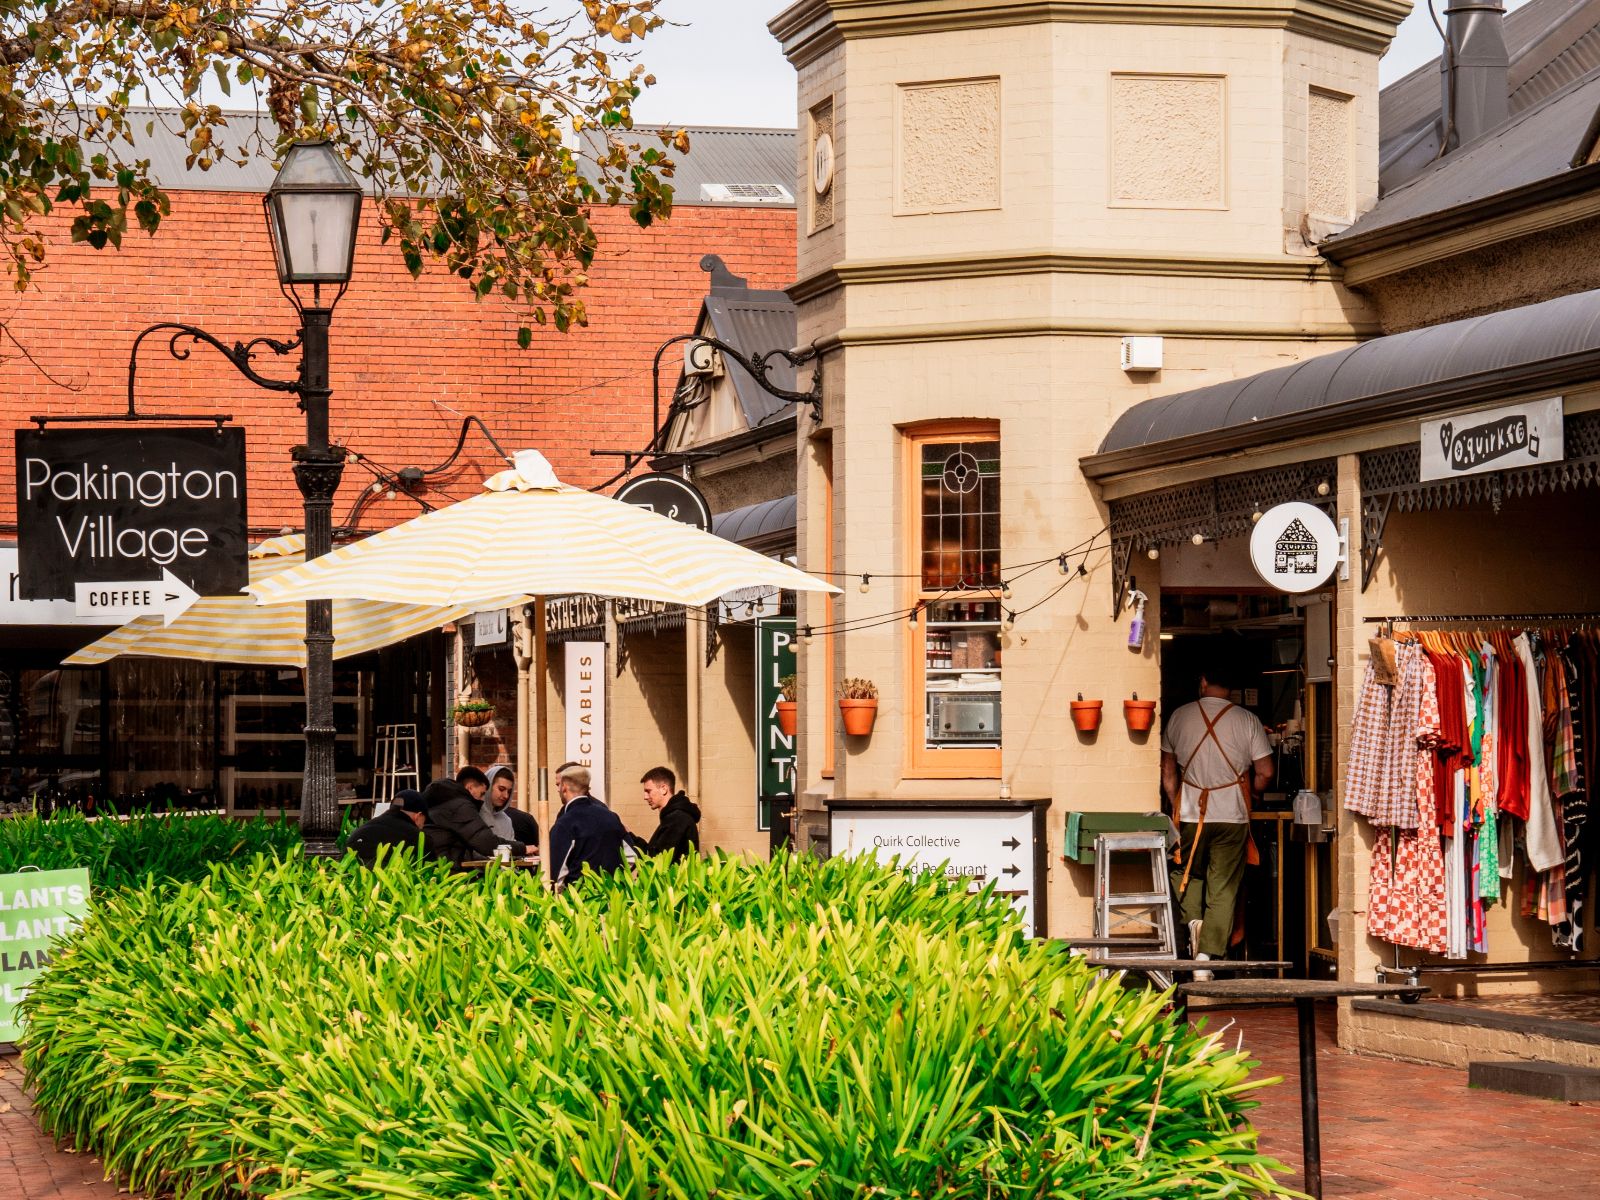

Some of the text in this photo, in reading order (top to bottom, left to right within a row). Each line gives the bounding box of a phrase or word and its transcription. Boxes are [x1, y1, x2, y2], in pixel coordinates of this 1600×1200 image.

[25, 457, 238, 507] Pakington
[56, 515, 209, 564] Village
[89, 590, 151, 607] COFFEE
[580, 655, 592, 769] ECTABLES
[873, 835, 961, 848] Quirk Collective
[896, 862, 918, 875] ad
[1, 949, 65, 972] LAN
